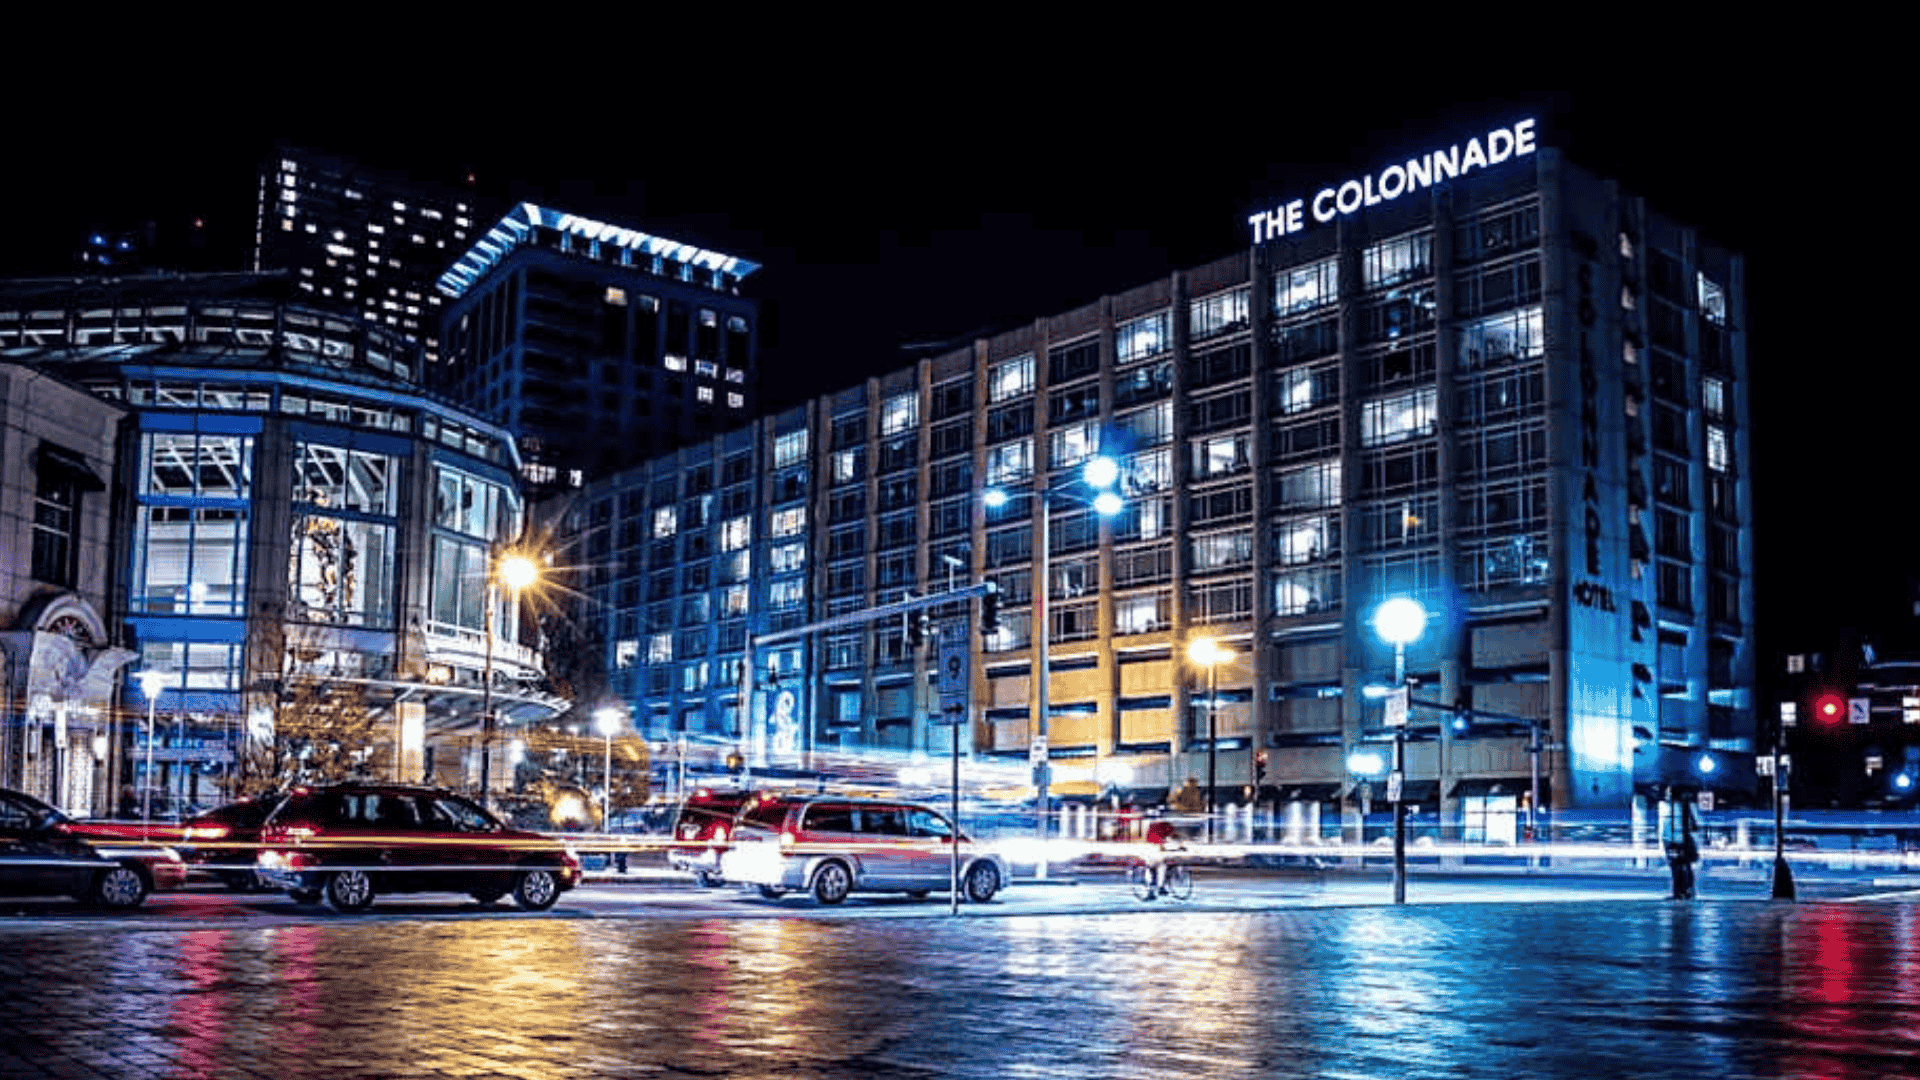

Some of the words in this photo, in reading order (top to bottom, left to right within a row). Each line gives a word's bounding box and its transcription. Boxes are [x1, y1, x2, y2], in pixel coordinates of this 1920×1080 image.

[1248, 199, 1304, 244] THE
[1312, 118, 1536, 222] COLONNADE
[1572, 581, 1616, 614] HOTEL
